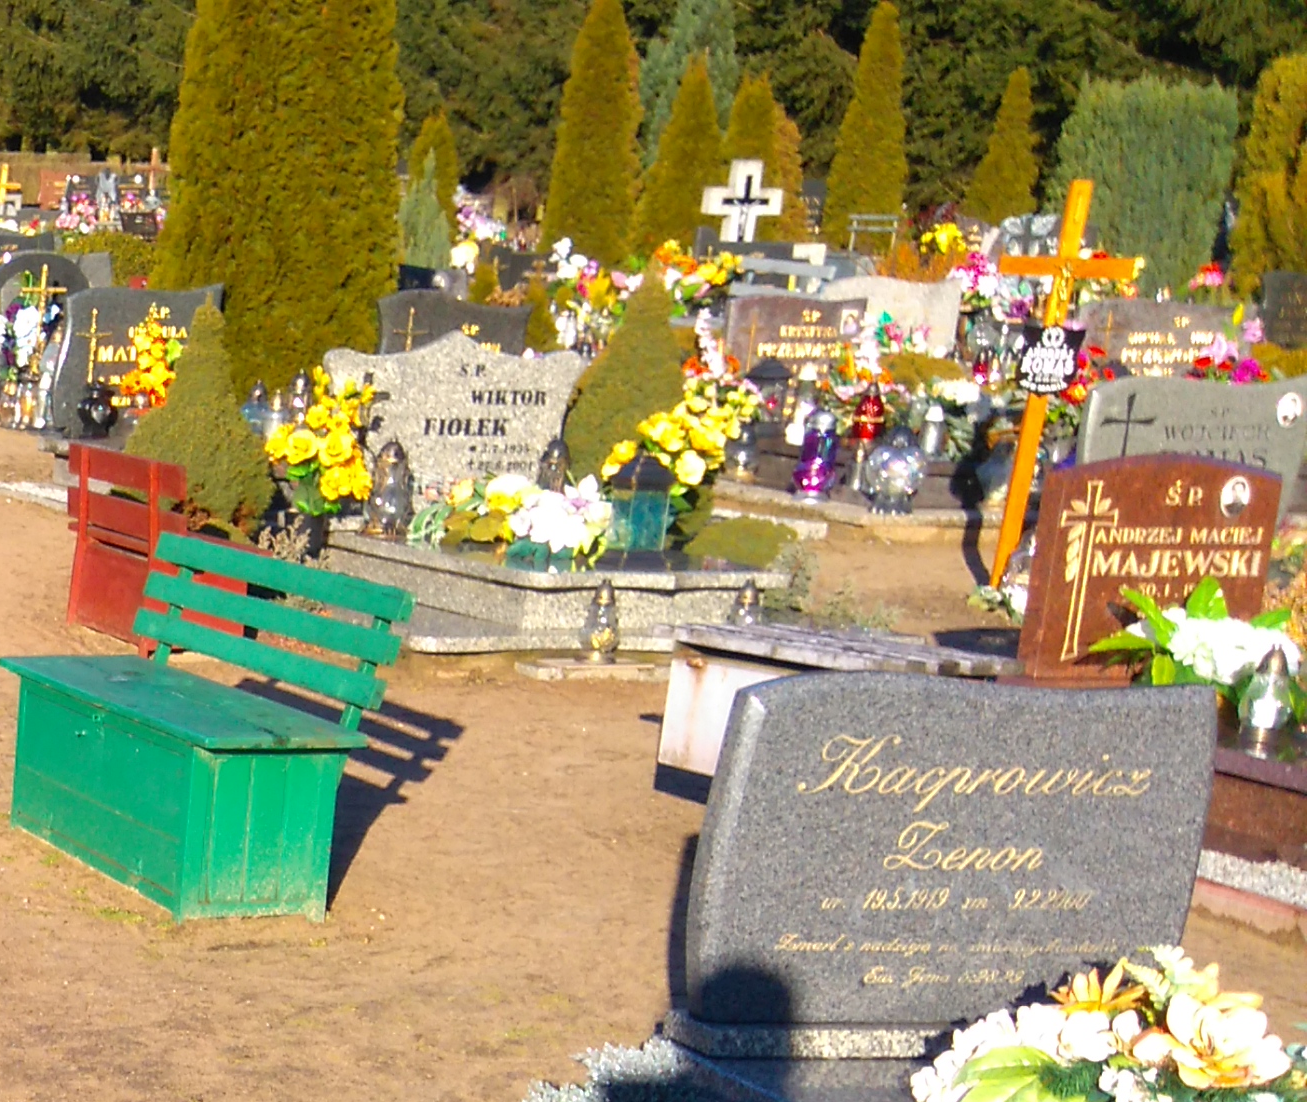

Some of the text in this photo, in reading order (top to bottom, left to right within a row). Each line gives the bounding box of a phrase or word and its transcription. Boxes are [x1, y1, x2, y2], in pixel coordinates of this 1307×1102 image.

[471, 390, 547, 406] WIKTOR
[1095, 526, 1264, 546] ANDRZEJ MACIEJ
[1091, 550, 1263, 577] MAJEWSKI
[797, 733, 1152, 813] Kacprowicz
[884, 820, 1044, 872] Zenon
